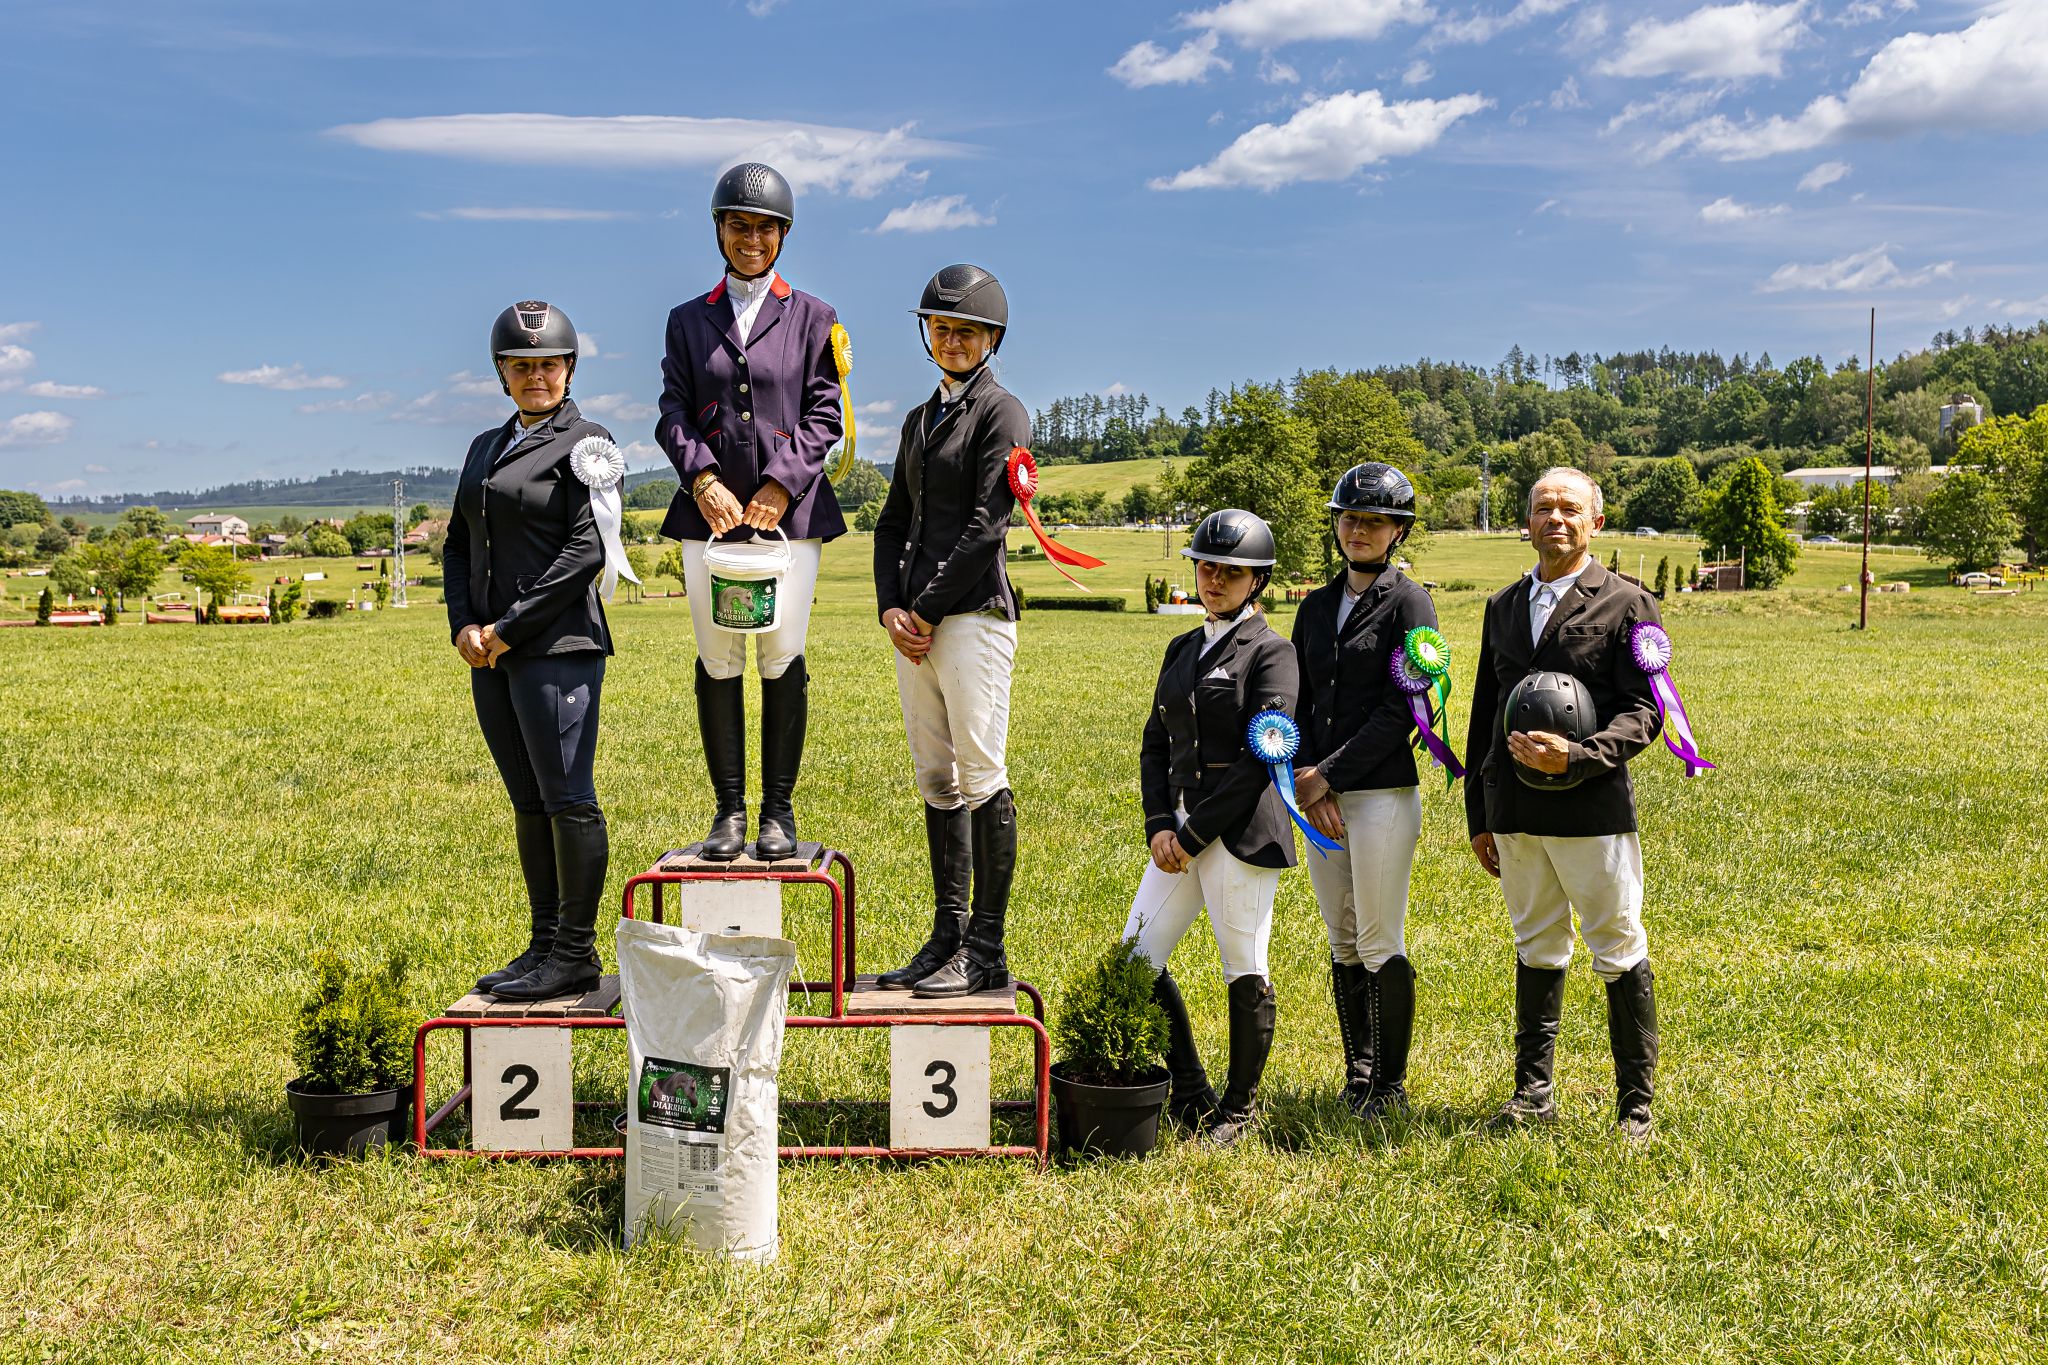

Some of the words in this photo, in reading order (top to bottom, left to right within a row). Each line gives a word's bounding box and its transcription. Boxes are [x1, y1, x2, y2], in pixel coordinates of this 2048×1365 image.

[500, 1064, 540, 1121] 2
[661, 1094, 674, 1103] BYE
[675, 1096, 687, 1106] BYE
[922, 1060, 958, 1118] 3
[652, 1100, 692, 1115] DIARRHEA
